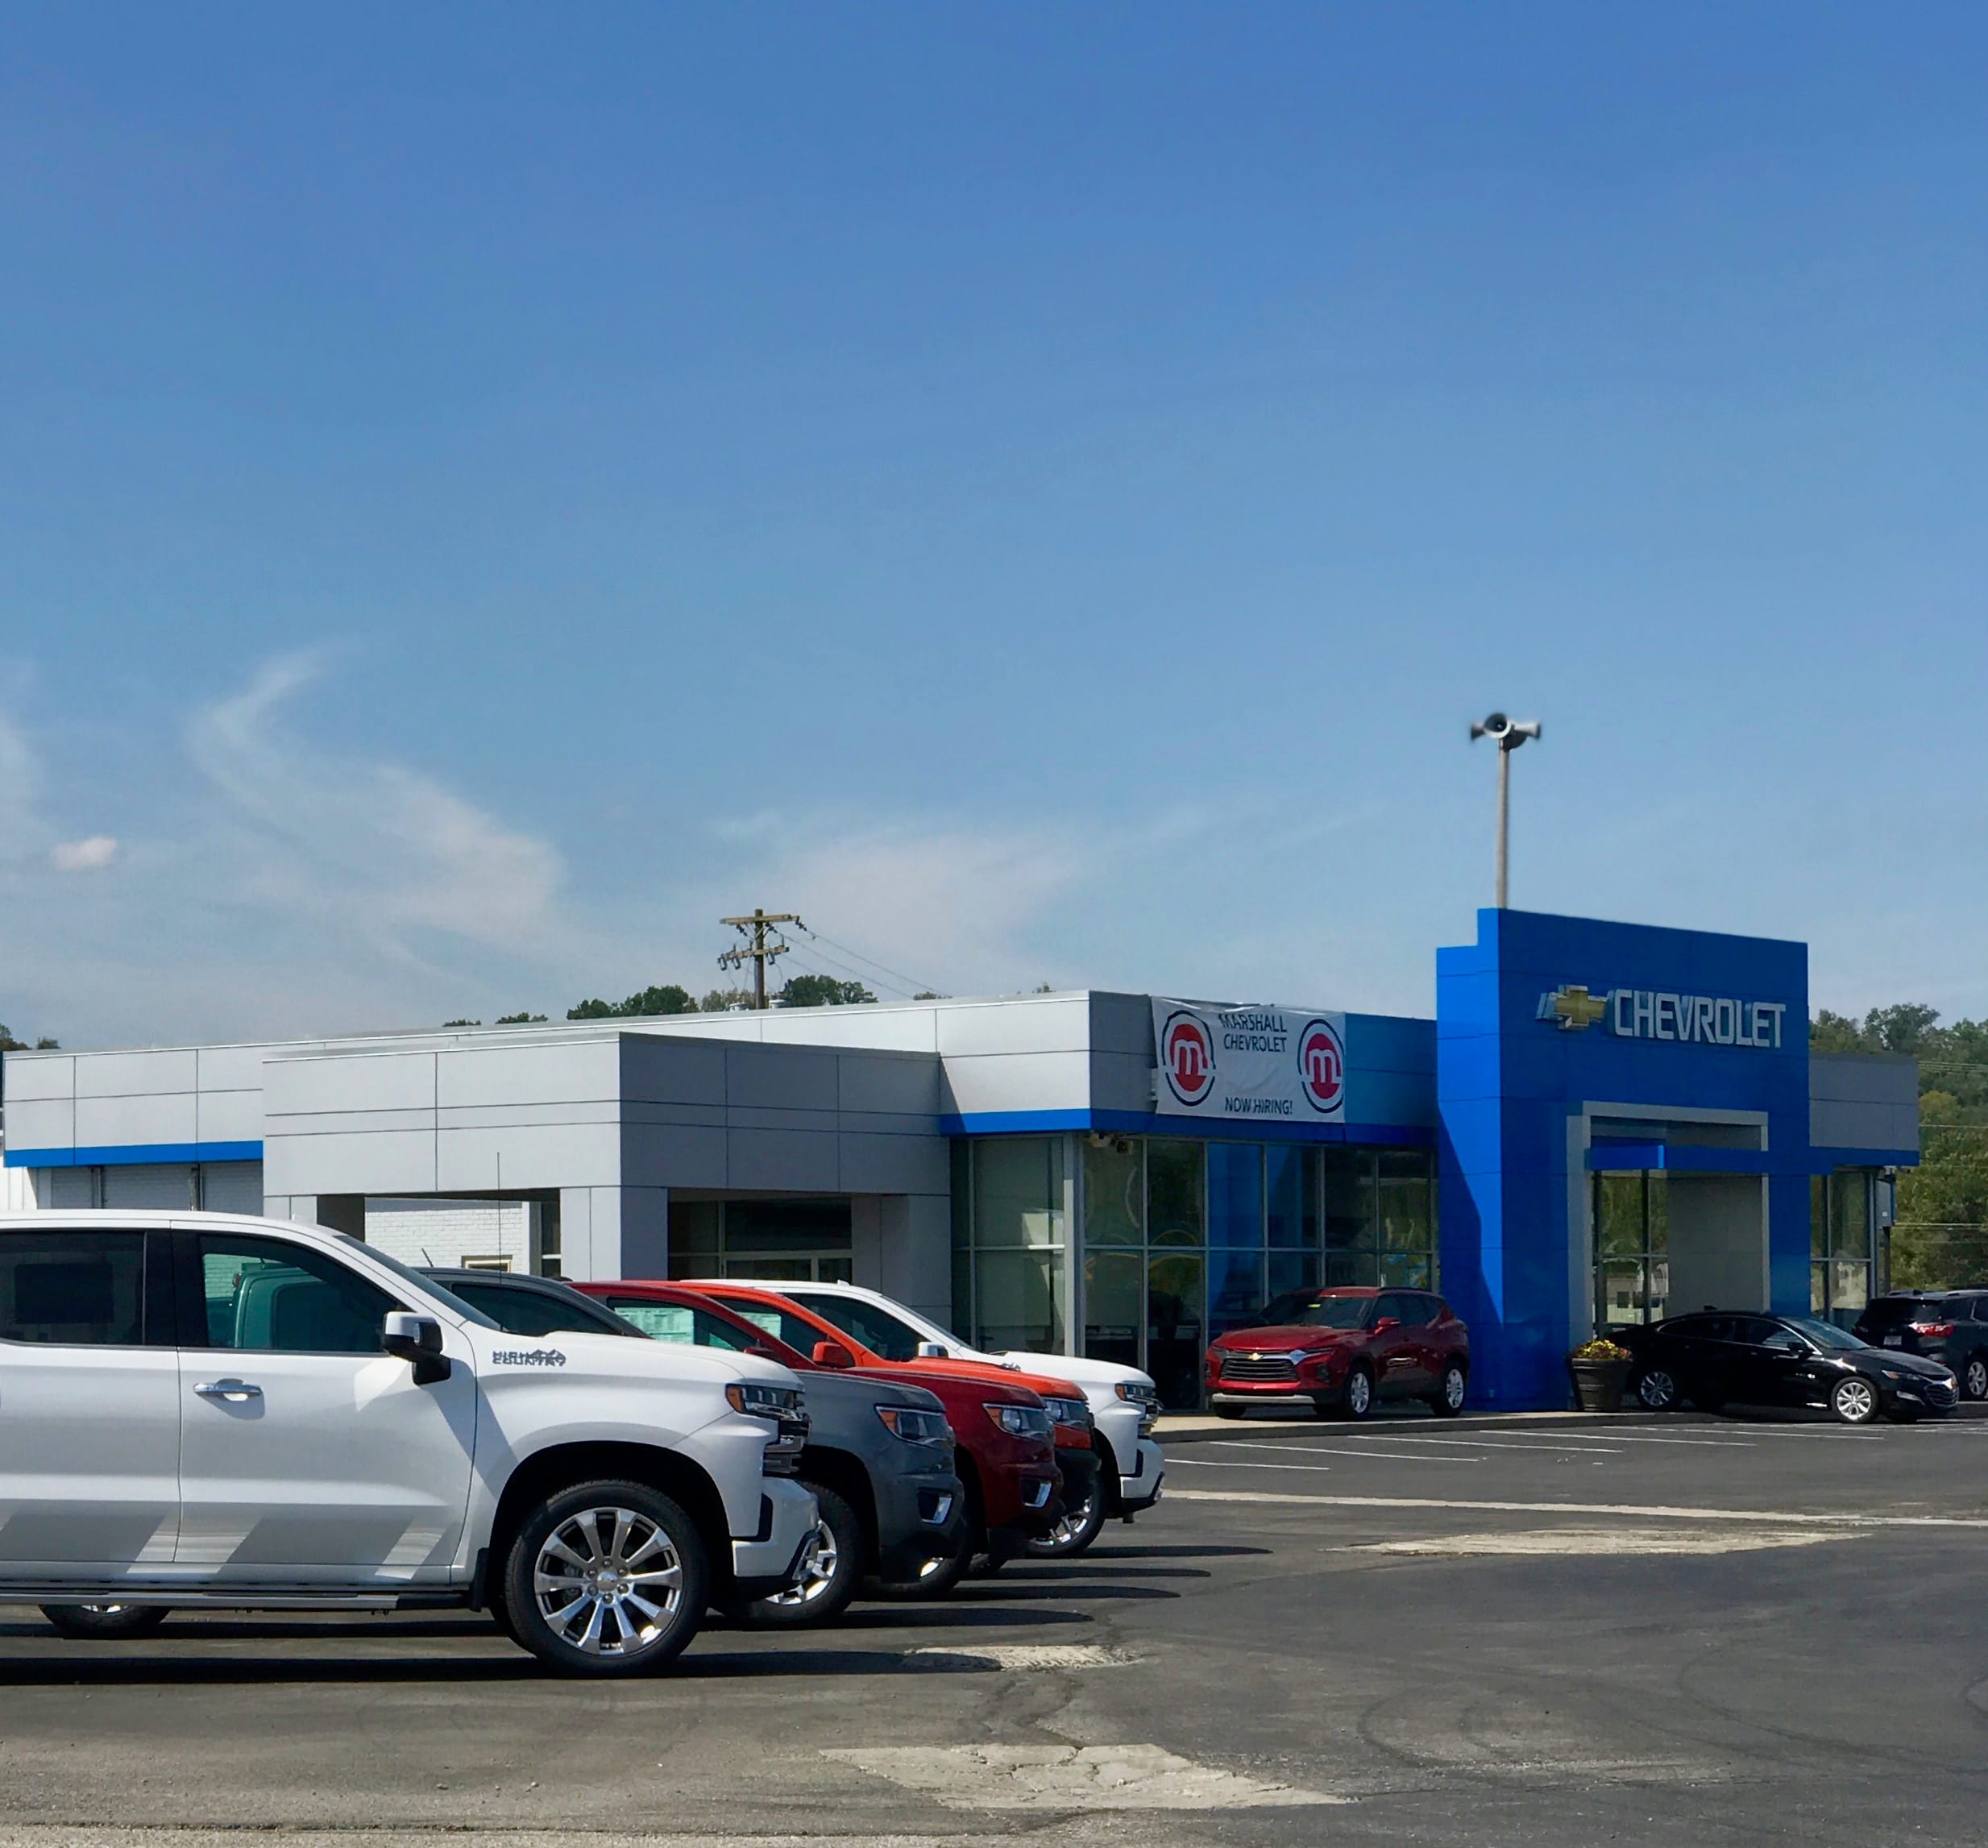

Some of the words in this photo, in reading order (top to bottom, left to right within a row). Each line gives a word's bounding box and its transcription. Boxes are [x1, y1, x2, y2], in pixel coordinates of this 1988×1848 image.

[1218, 1013, 1287, 1032] MARSHALL
[1614, 989, 1787, 1048] CHEVROLET
[1223, 1033, 1287, 1052] CHEVROLET
[1224, 1097, 1252, 1113] NOW
[1252, 1098, 1293, 1115] HIRING!
